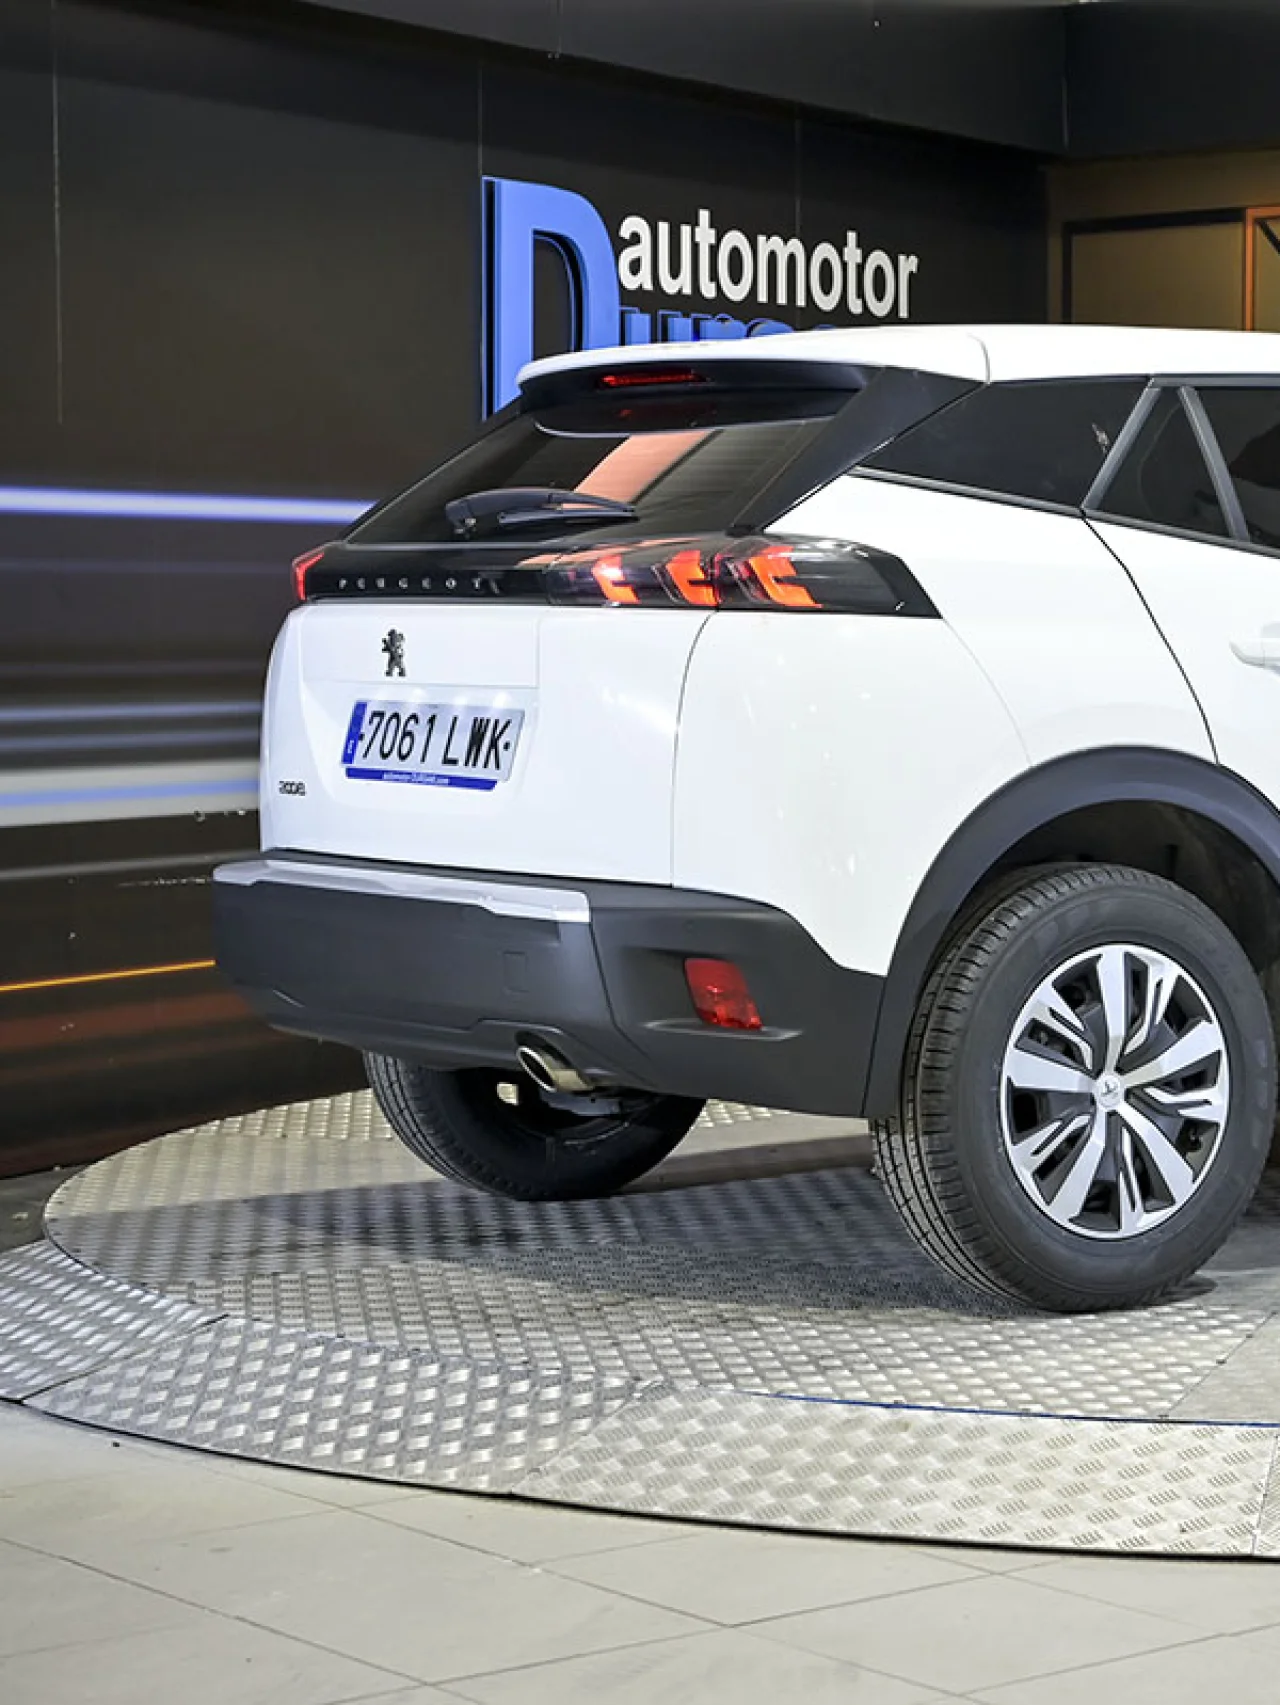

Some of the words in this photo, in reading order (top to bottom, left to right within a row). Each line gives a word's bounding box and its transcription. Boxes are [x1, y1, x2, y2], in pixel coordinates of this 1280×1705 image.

[618, 208, 919, 319] automotor
[338, 577, 482, 590] PEUGEOT
[362, 711, 436, 763] 7061
[441, 715, 511, 770] LWK
